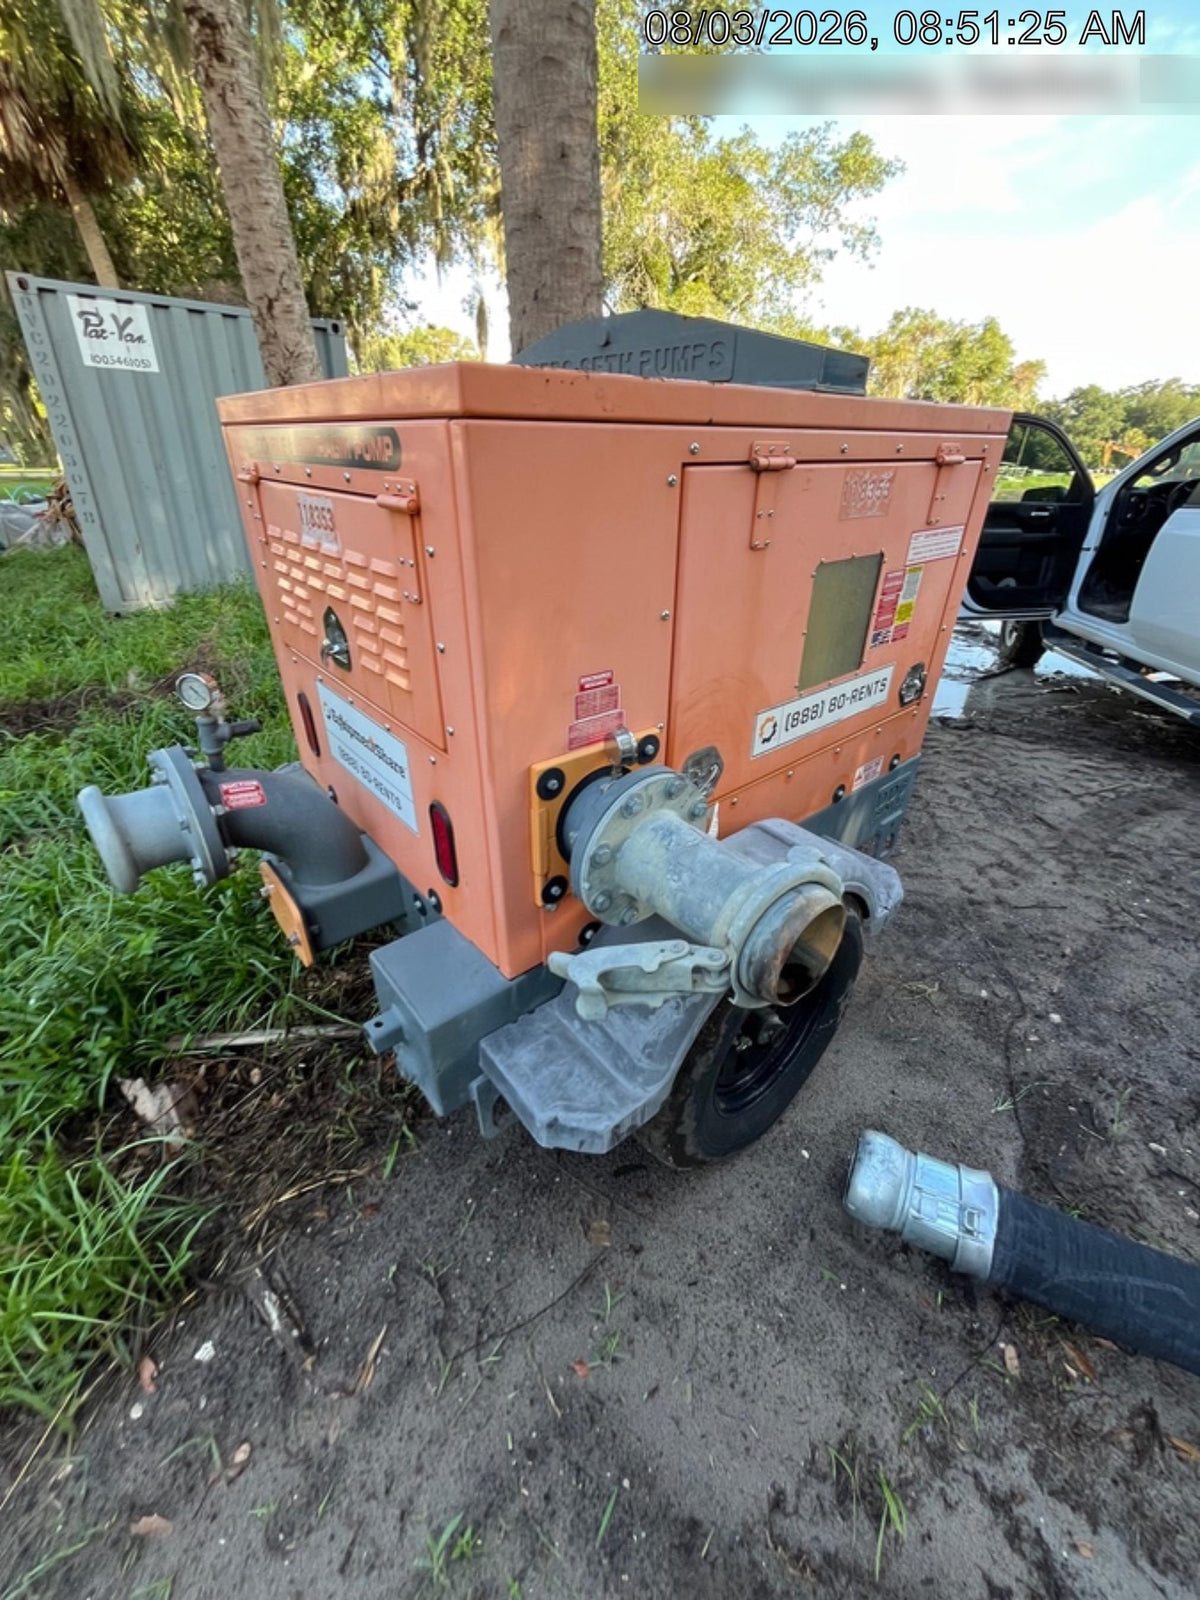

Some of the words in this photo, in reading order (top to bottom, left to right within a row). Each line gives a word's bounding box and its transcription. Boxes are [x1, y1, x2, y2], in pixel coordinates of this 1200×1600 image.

[639, 340, 727, 378] PUMPS
[784, 700, 826, 732] (888)
[828, 677, 888, 713] 80-RENTS
